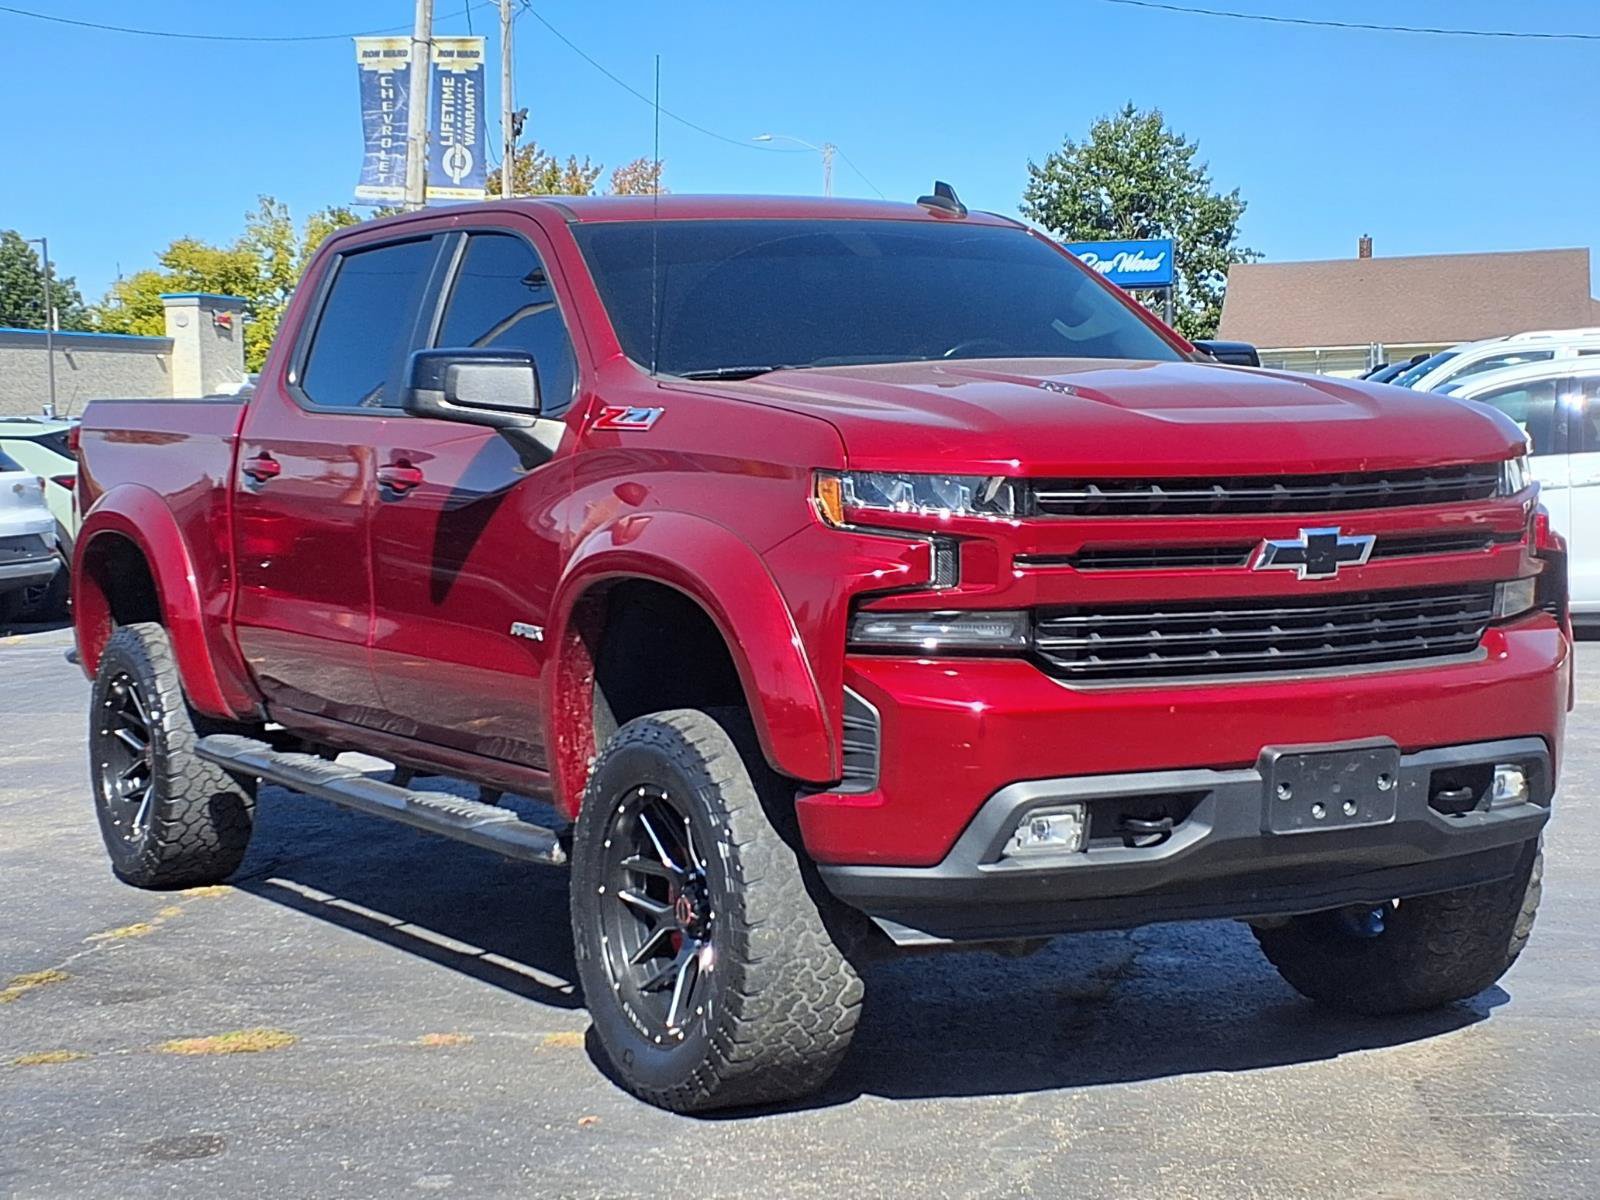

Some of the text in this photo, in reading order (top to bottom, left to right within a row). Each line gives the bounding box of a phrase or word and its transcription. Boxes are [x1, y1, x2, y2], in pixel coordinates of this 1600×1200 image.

[362, 49, 380, 58] RON
[437, 49, 456, 58] RON
[378, 76, 394, 183] CHEVROLET
[440, 76, 455, 146] LIFETIME
[464, 78, 475, 146] WARRANTY
